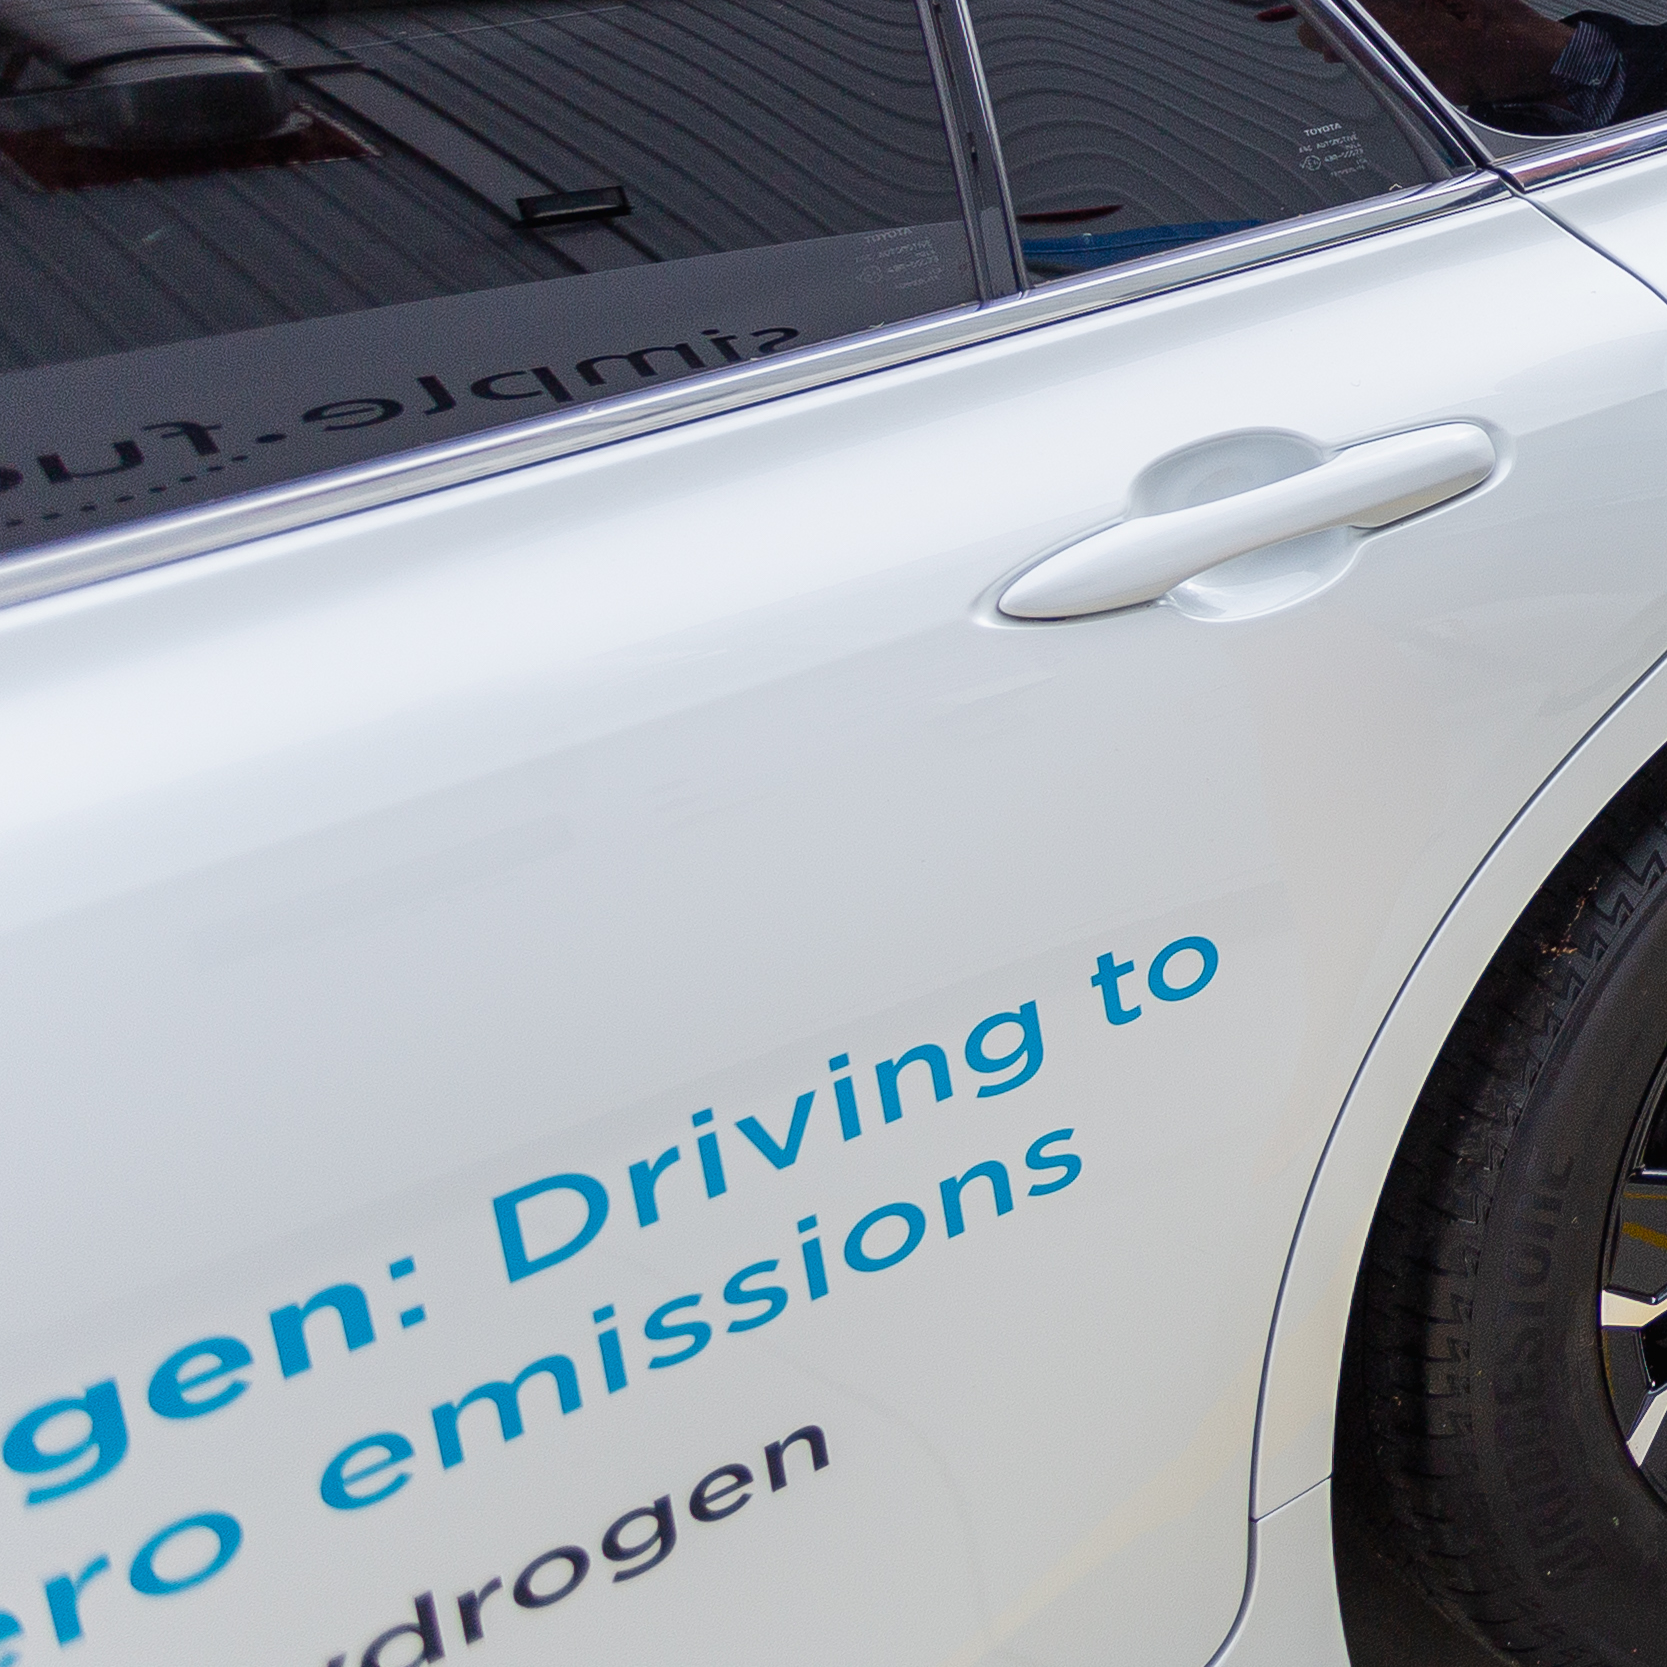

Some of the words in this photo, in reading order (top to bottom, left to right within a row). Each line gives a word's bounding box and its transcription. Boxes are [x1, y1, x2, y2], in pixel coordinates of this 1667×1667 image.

[1303, 122, 1342, 136] TOYOTA
[0, 1511, 243, 1667] ro
[318, 1127, 1083, 1511] emissions
[2, 1253, 427, 1506] gen:
[491, 999, 1045, 1283] Driving
[1090, 935, 1219, 1026] to
[325, 1424, 830, 1667] drogen
